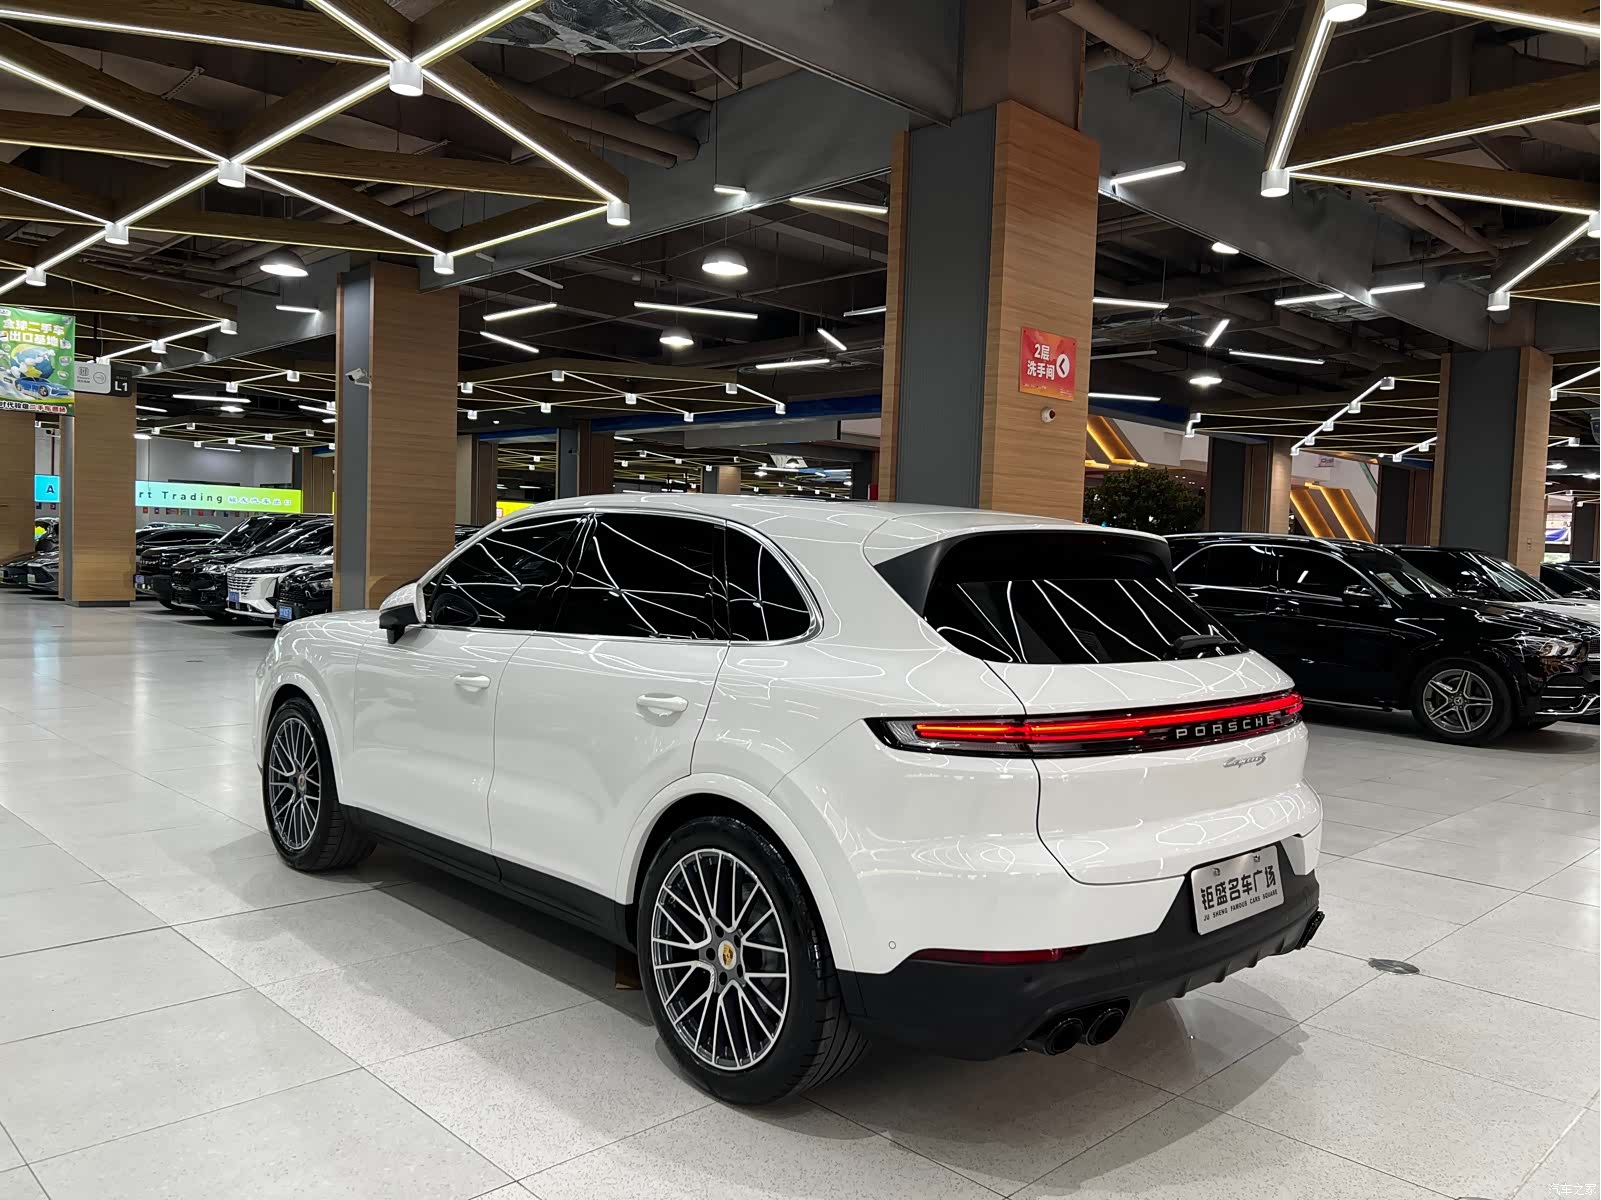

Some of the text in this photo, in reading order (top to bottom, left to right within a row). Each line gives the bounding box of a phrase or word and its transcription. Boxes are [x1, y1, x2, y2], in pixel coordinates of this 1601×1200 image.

[3, 319, 65, 335] 全球二手车
[10, 330, 59, 347] 出口基地
[1034, 343, 1050, 361] 2层
[1027, 360, 1055, 380] 洗手间
[114, 381, 128, 391] L1
[162, 491, 223, 503] Trading
[1176, 714, 1275, 739] PORSCHE
[1201, 865, 1276, 910] 钜盛名车广场
[1213, 907, 1229, 919] SHENG
[1230, 901, 1248, 912] FAMOUS
[1249, 895, 1261, 905] CARS
[1262, 889, 1278, 900] SQUARE
